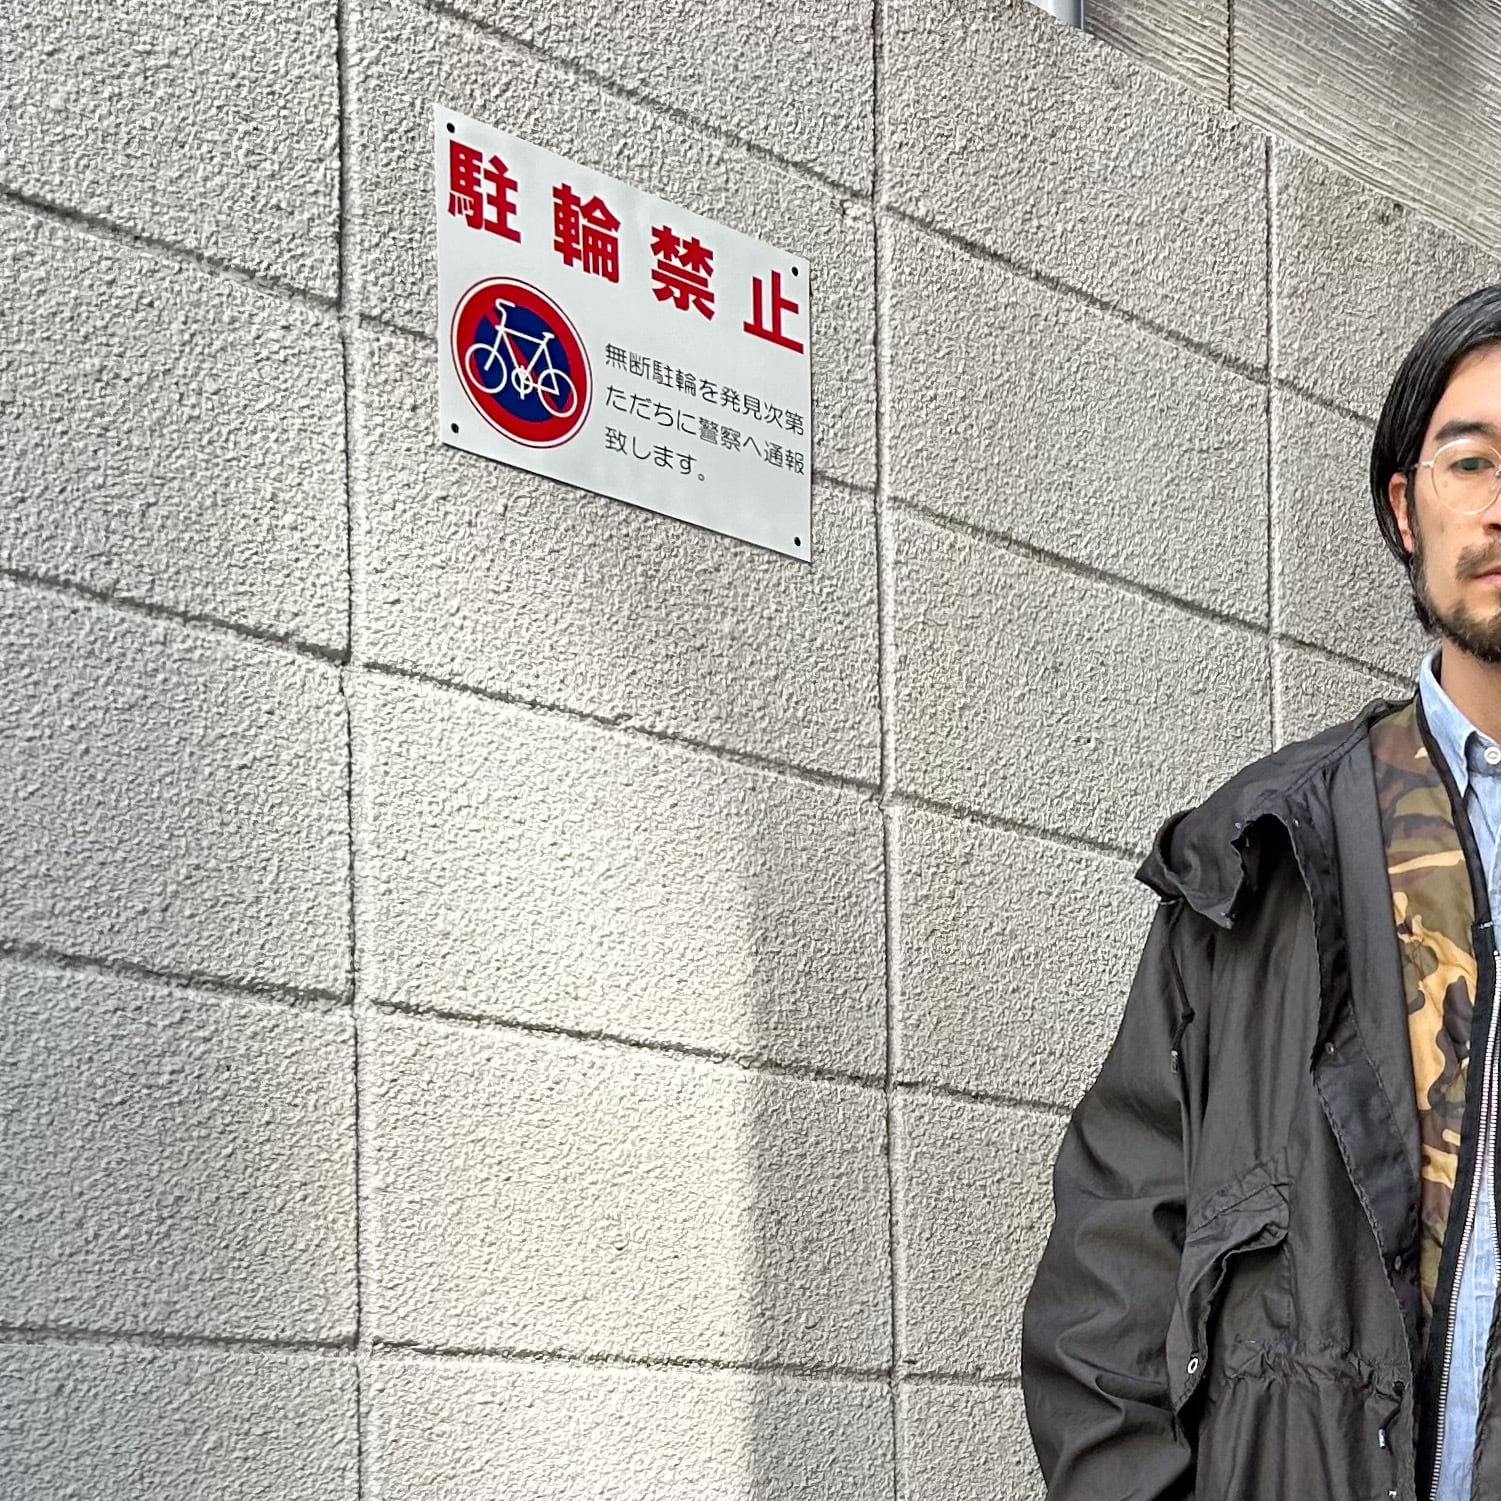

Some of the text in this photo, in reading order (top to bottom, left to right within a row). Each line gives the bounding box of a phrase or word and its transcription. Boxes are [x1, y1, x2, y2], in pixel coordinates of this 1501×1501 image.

[448, 139, 805, 354] 駐輪禁止
[605, 342, 805, 436] 無断駐輪を発見次第
[605, 384, 805, 476] ただちに警察へ通報
[604, 426, 707, 482] 致します。
